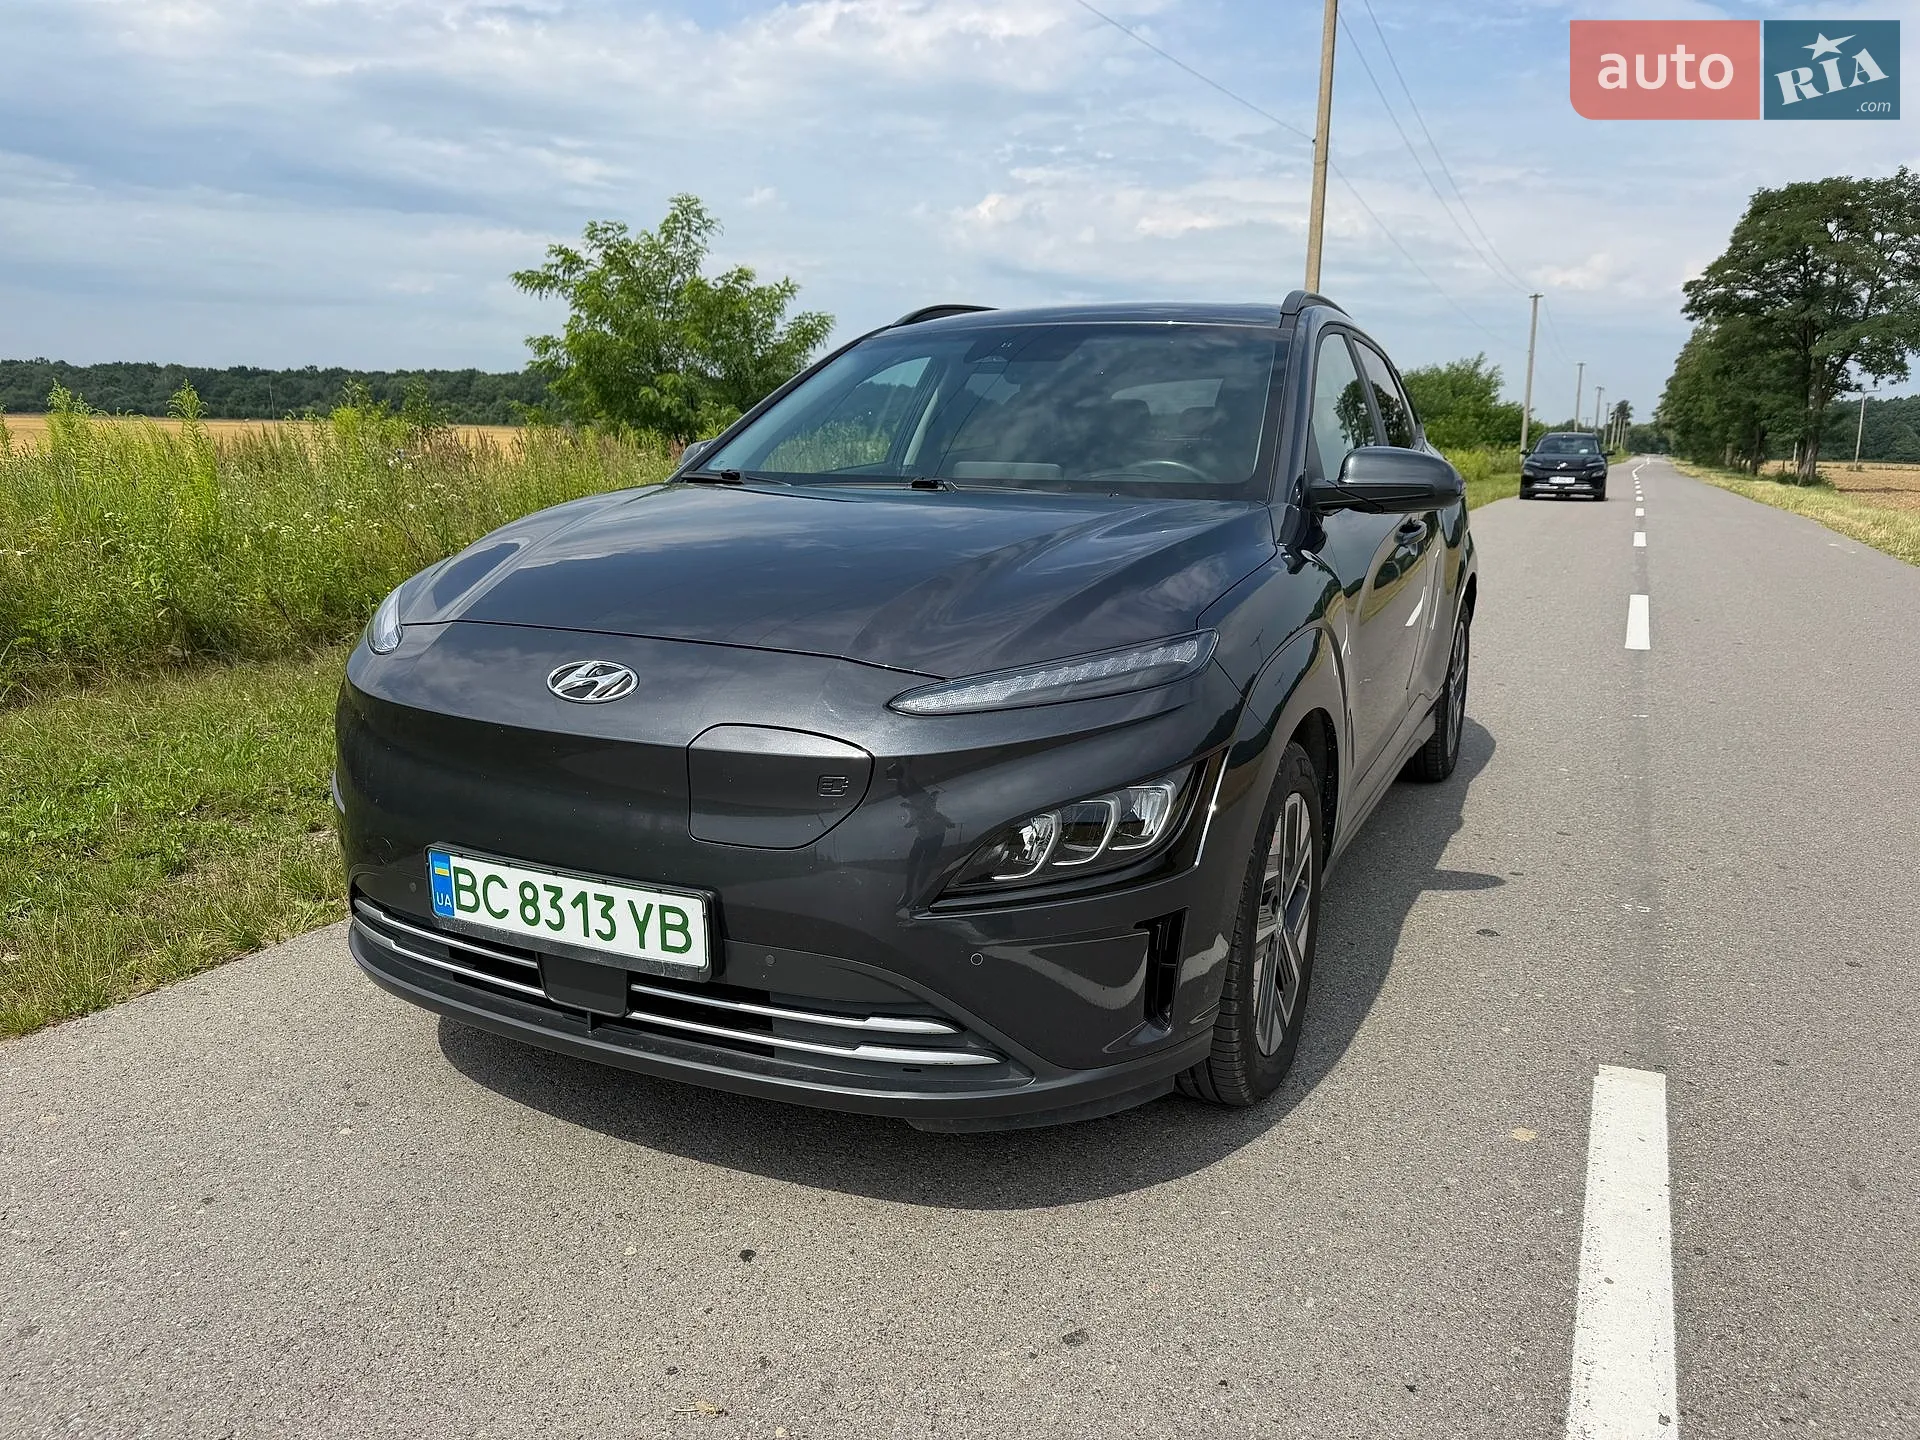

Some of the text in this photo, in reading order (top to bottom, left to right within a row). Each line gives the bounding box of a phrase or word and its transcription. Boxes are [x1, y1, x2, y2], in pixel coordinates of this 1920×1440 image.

[436, 893, 453, 909] UA
[453, 865, 693, 954] BC 8313 YB
